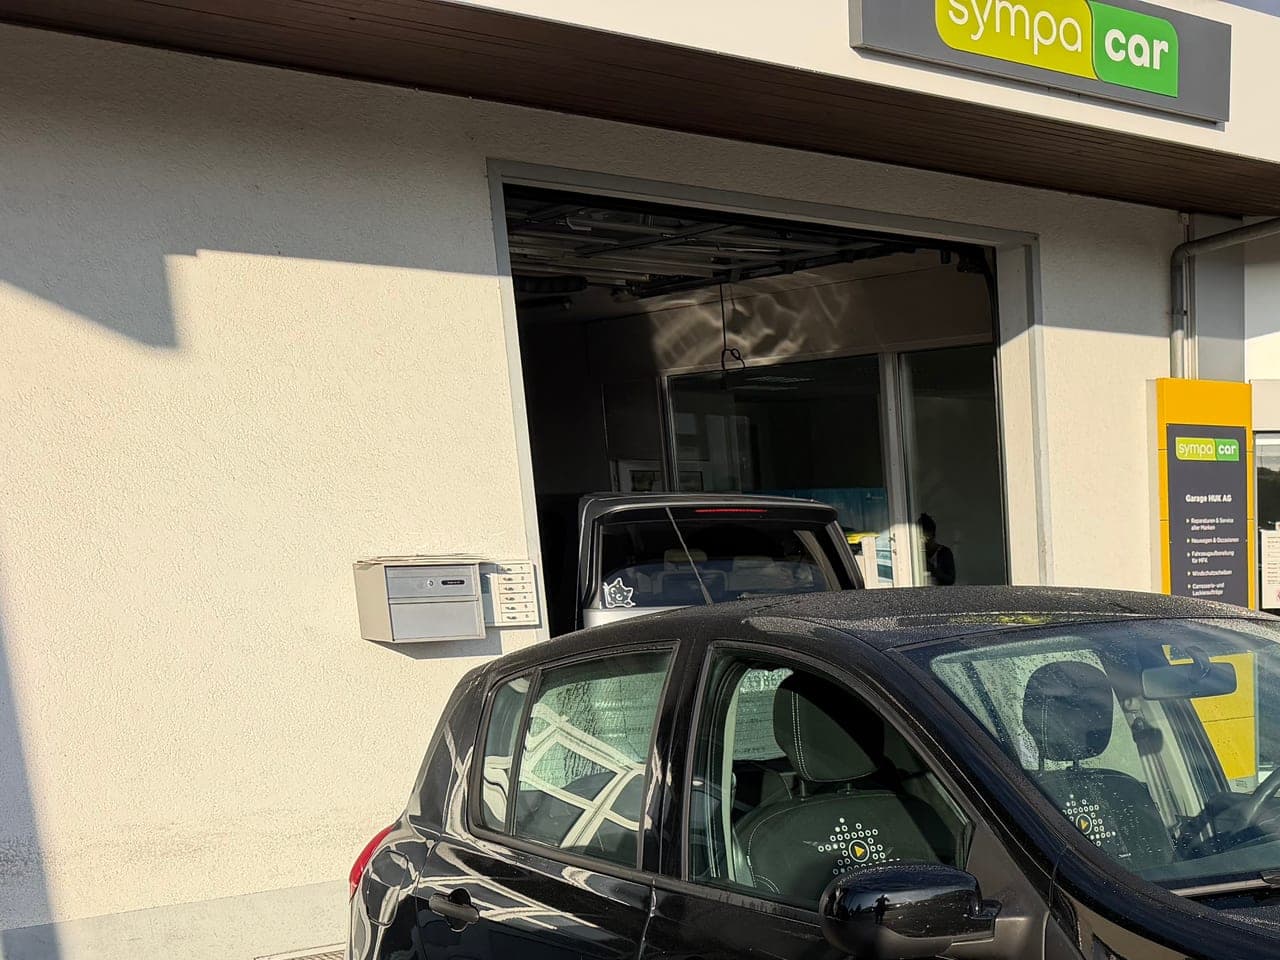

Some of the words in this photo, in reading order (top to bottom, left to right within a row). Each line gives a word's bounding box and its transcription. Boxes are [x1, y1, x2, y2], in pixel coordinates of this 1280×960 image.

[947, 0, 1083, 56] sympa
[1104, 28, 1169, 70] car
[1178, 444, 1213, 457] sympa
[1218, 445, 1236, 455] car
[1185, 494, 1208, 504] Garage
[1208, 494, 1222, 502] HUK
[1222, 494, 1232, 502] AG
